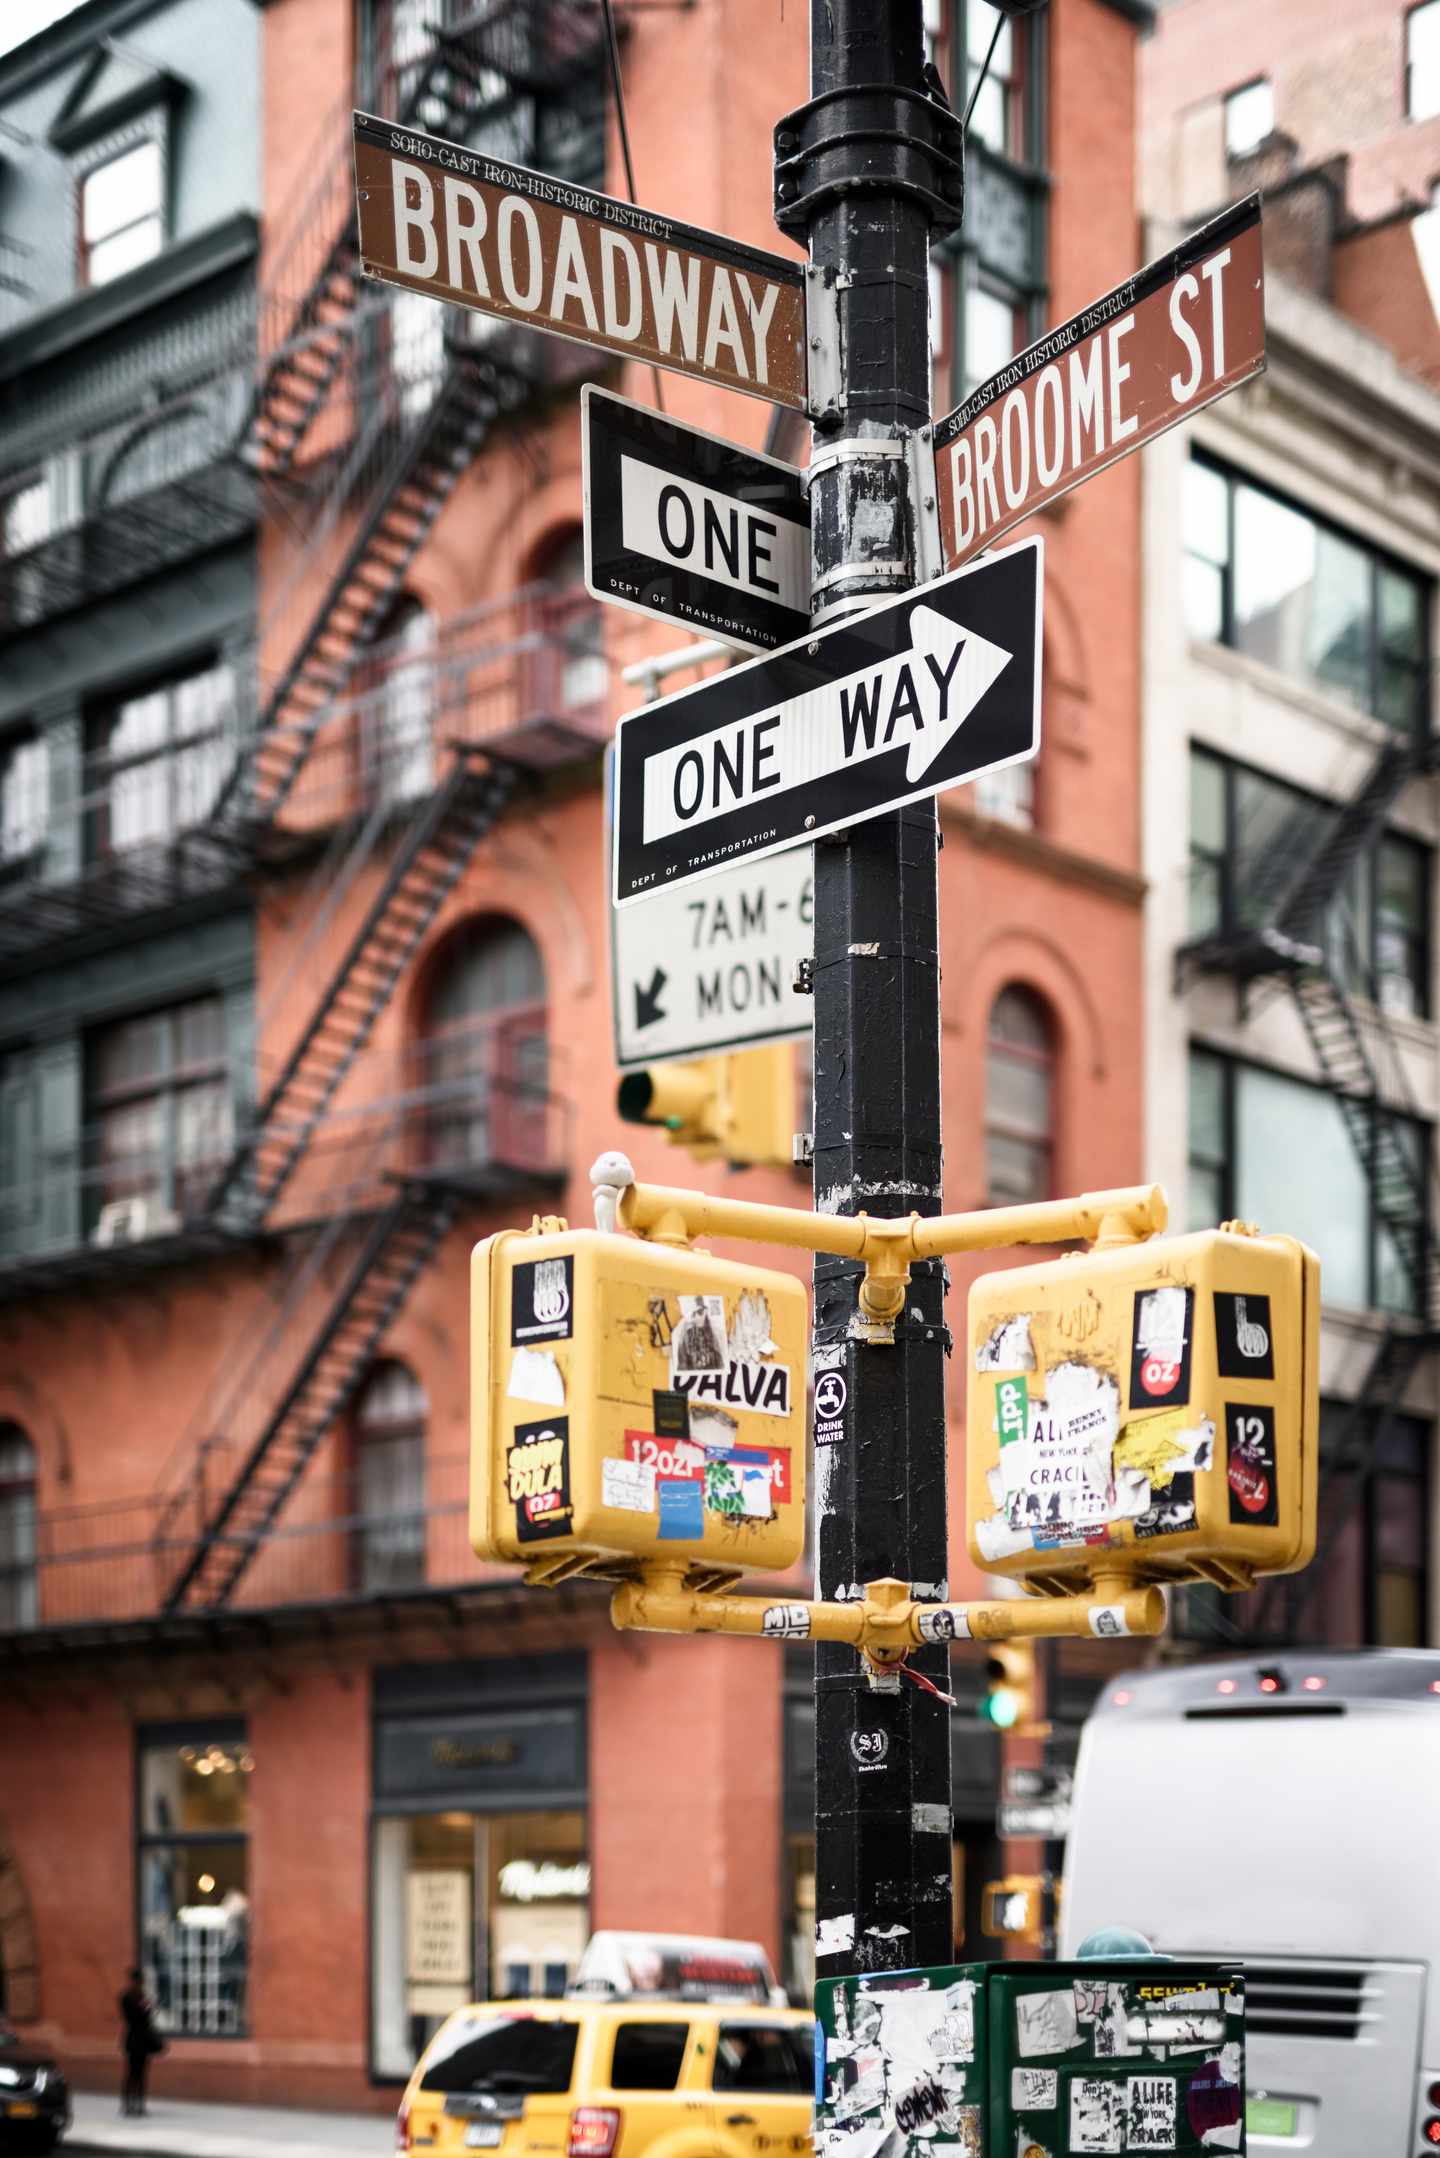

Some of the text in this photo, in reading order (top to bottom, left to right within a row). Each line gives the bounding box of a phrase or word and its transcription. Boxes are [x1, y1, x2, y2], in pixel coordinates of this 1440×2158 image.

[604, 202, 673, 239] DISTRICT
[391, 158, 780, 385] BROADWAY
[996, 361, 1023, 394] IRON
[1024, 323, 1079, 373] HISTORIC
[1081, 284, 1136, 334] DISTRICT
[950, 248, 1231, 554] BROOME ST
[657, 484, 780, 595] ONE
[610, 578, 777, 645] DEPT OF TRANSPORTATION
[673, 640, 967, 820] ONE WAY
[632, 828, 777, 888] DEPT OF TRANSPORTATION
[817, 1420, 843, 1432] DRINK
[817, 1431, 844, 1444] WATER
